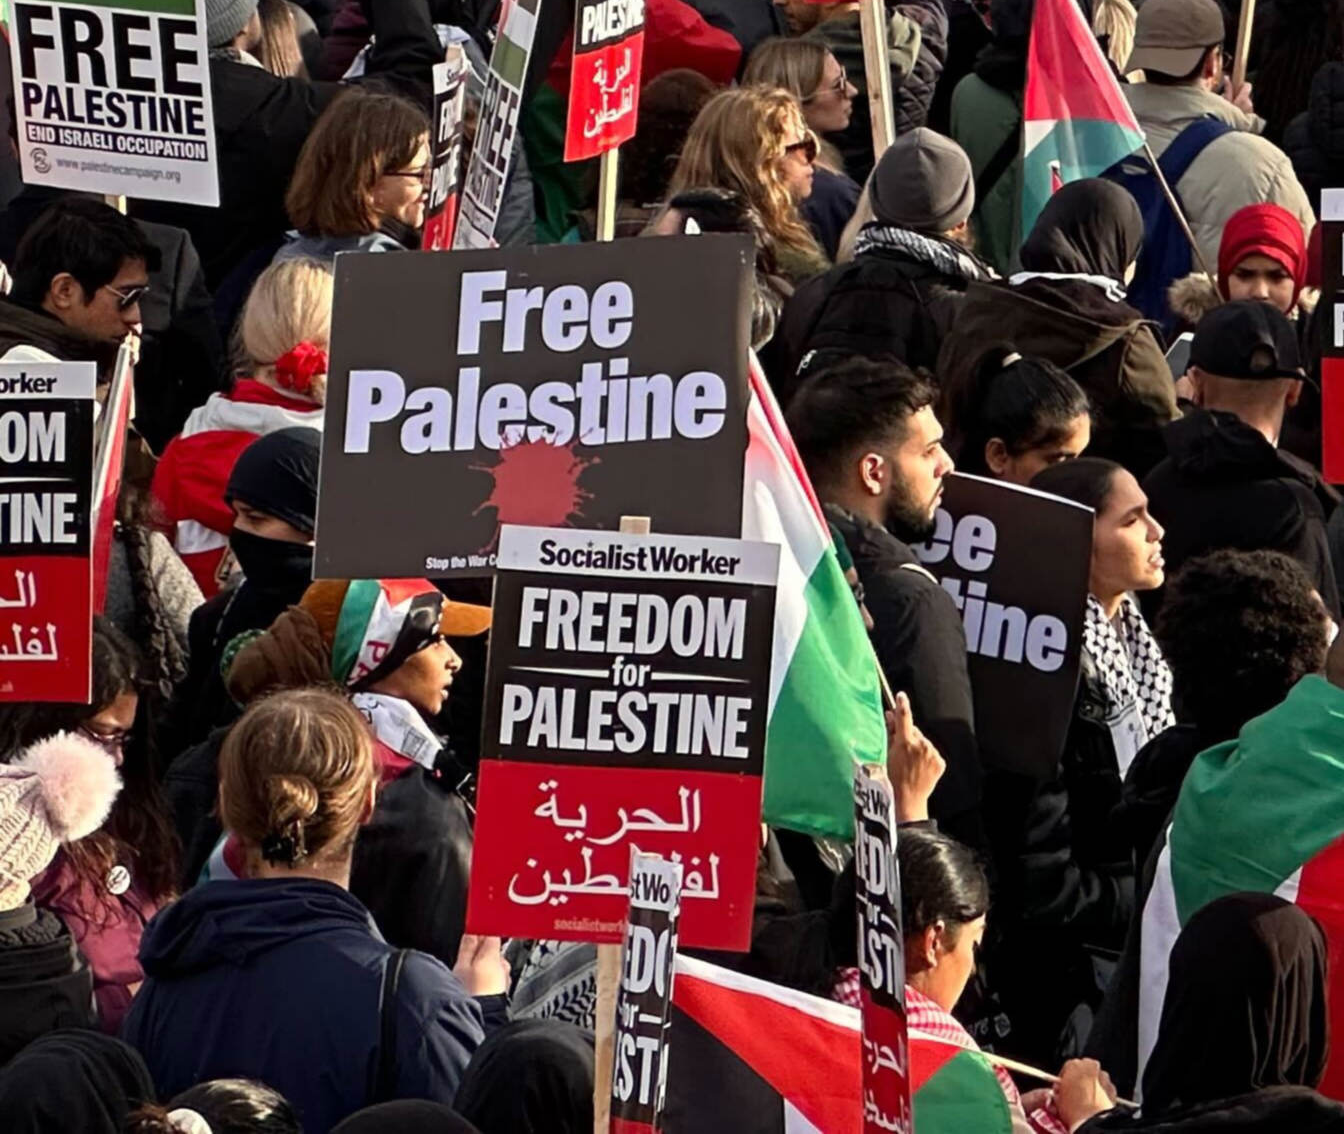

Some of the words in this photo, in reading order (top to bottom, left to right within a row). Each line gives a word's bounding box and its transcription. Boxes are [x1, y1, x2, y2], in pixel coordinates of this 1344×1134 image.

[14, 4, 201, 97] FREE
[22, 84, 207, 137] PALESTINE
[27, 124, 56, 144] END
[58, 129, 114, 151] ISRAELI
[116, 135, 206, 160] OCCUPATION
[456, 269, 634, 356] Free
[343, 357, 727, 454] Palestine
[539, 540, 649, 572] Socialist
[649, 546, 741, 576] Worker
[517, 587, 747, 660] FREEDOM
[611, 654, 651, 688] for
[499, 684, 753, 759] PALESTINE
